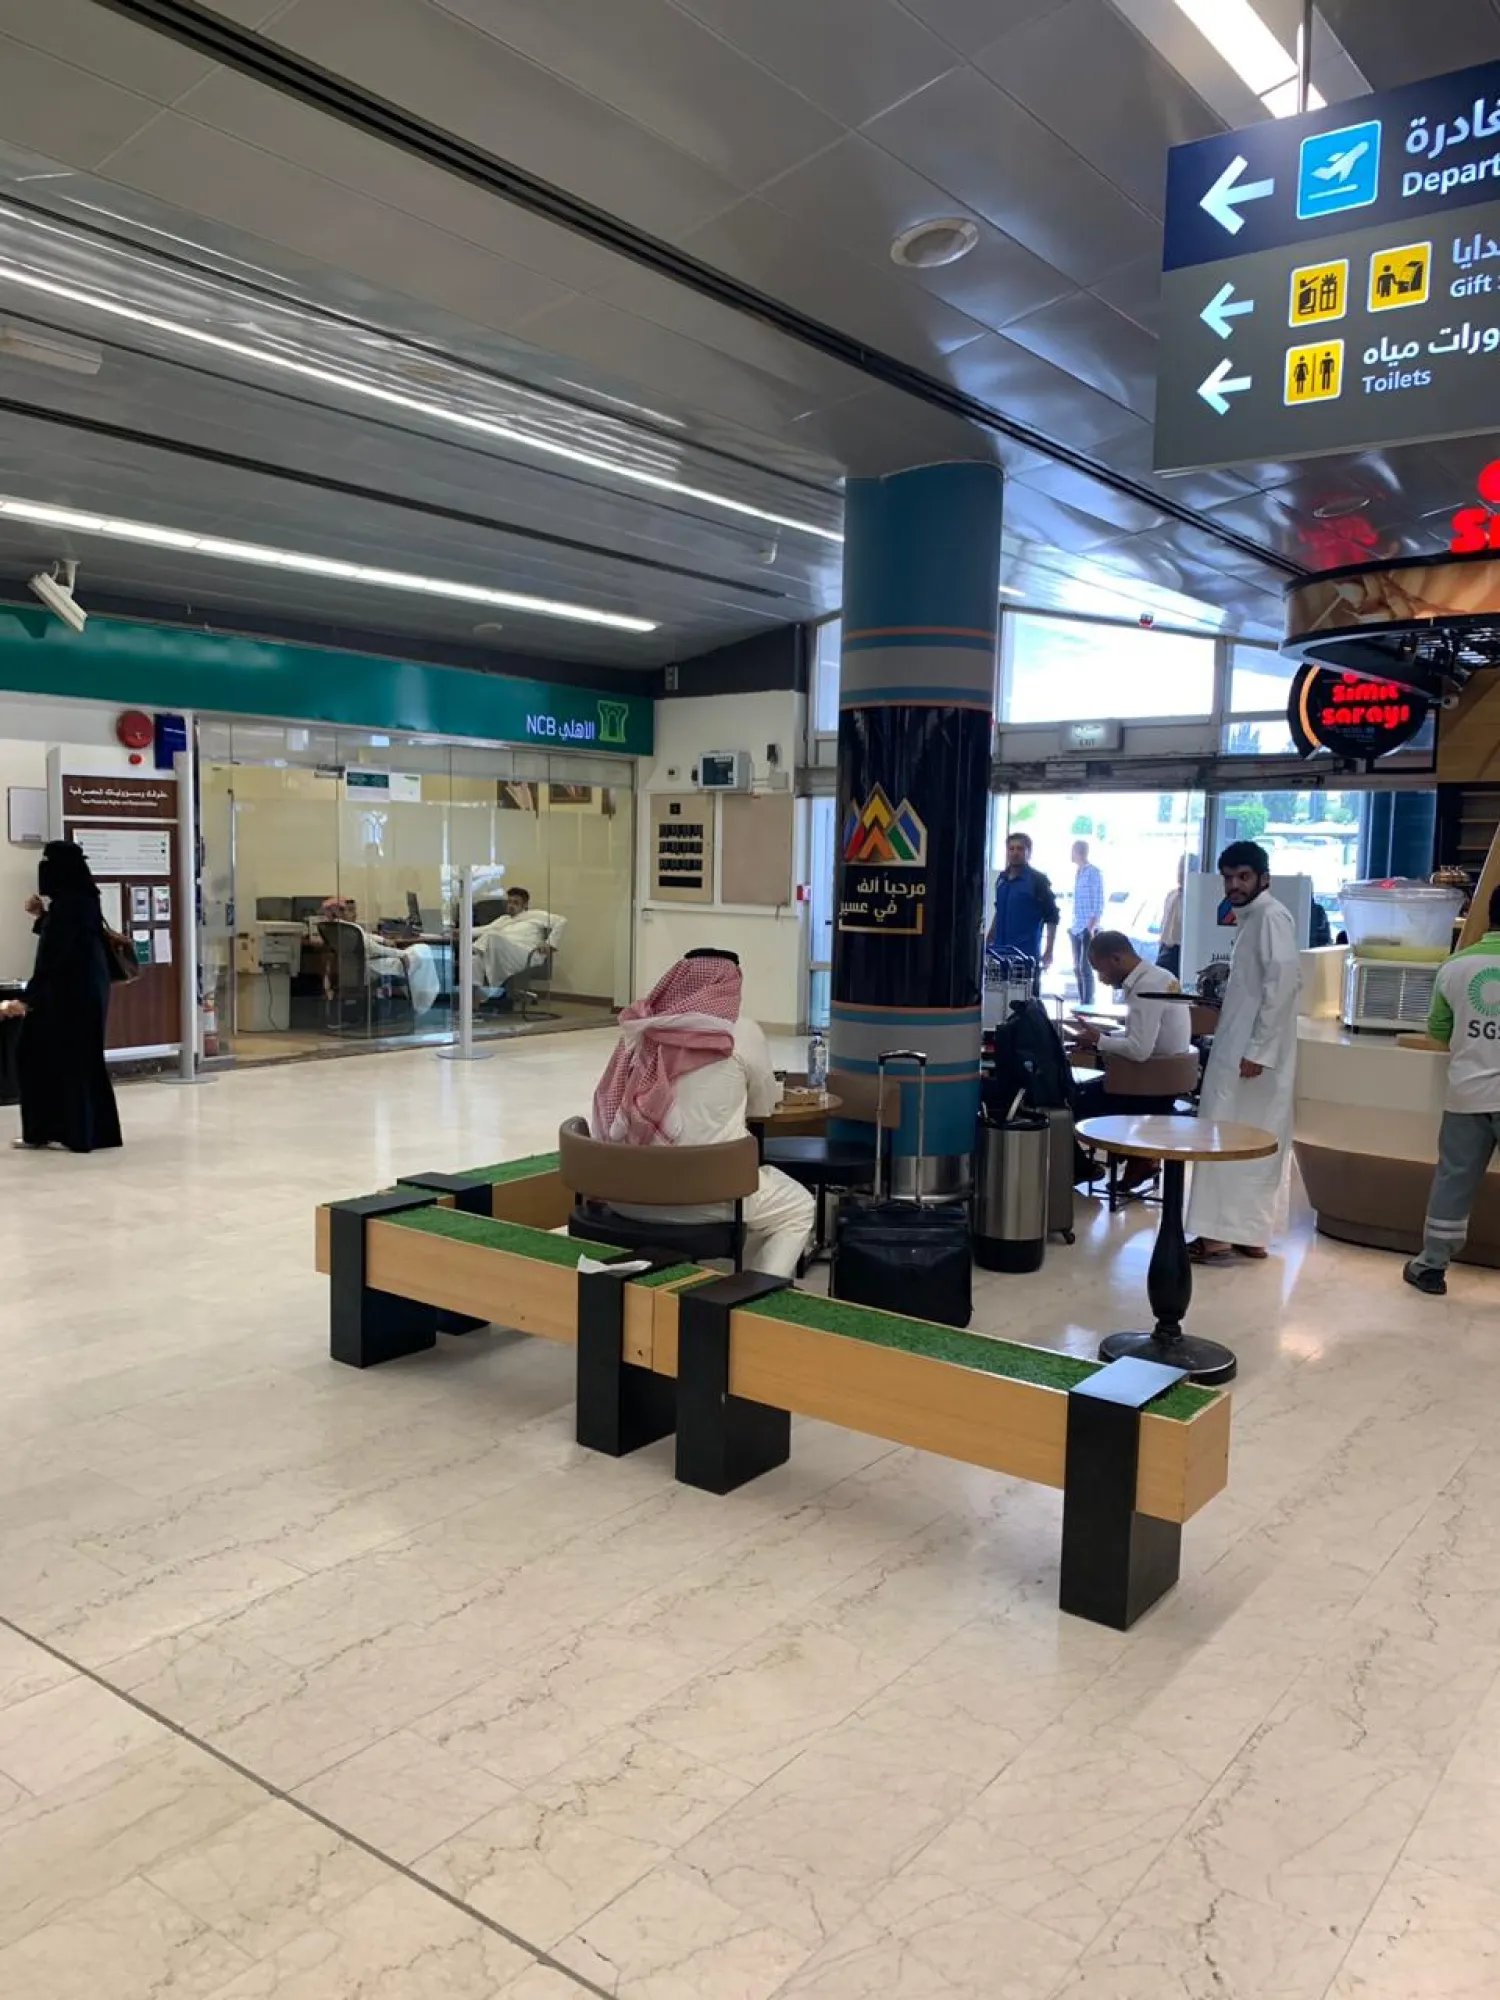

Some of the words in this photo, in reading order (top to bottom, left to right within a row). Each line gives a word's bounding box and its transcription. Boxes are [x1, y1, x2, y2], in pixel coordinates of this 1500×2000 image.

[1402, 153, 1500, 197] Depart
[1450, 273, 1492, 298] Gift
[1363, 336, 1420, 367] مياه
[1362, 369, 1432, 394] Toilets
[526, 714, 556, 737] NCB
[839, 901, 869, 917] عسير
[873, 899, 898, 923] في
[1467, 1019, 1500, 1040] SG
